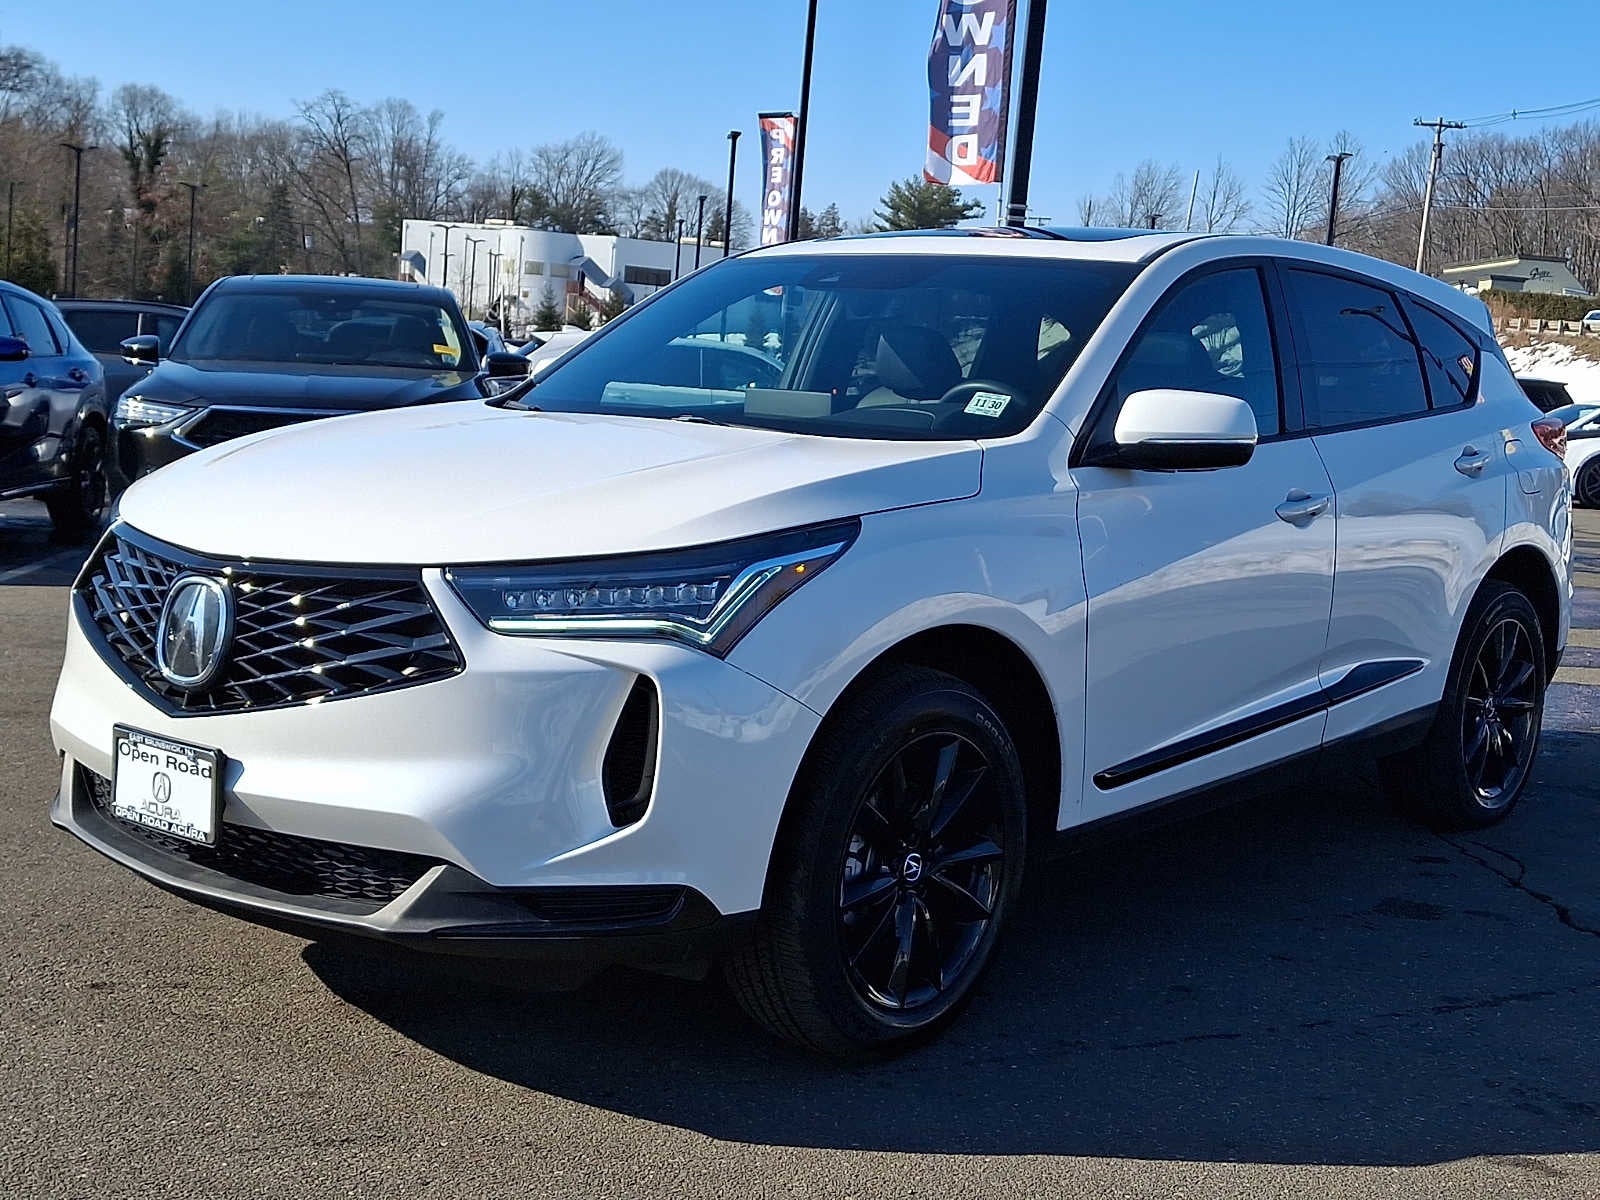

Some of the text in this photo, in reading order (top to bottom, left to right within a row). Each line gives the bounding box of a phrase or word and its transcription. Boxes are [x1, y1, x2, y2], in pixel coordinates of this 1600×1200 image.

[988, 400, 1003, 410] 30
[119, 742, 159, 765] Open
[166, 755, 212, 779] Road
[140, 799, 182, 820] ACURA
[115, 807, 207, 841] OPEN ROAD ACURA
